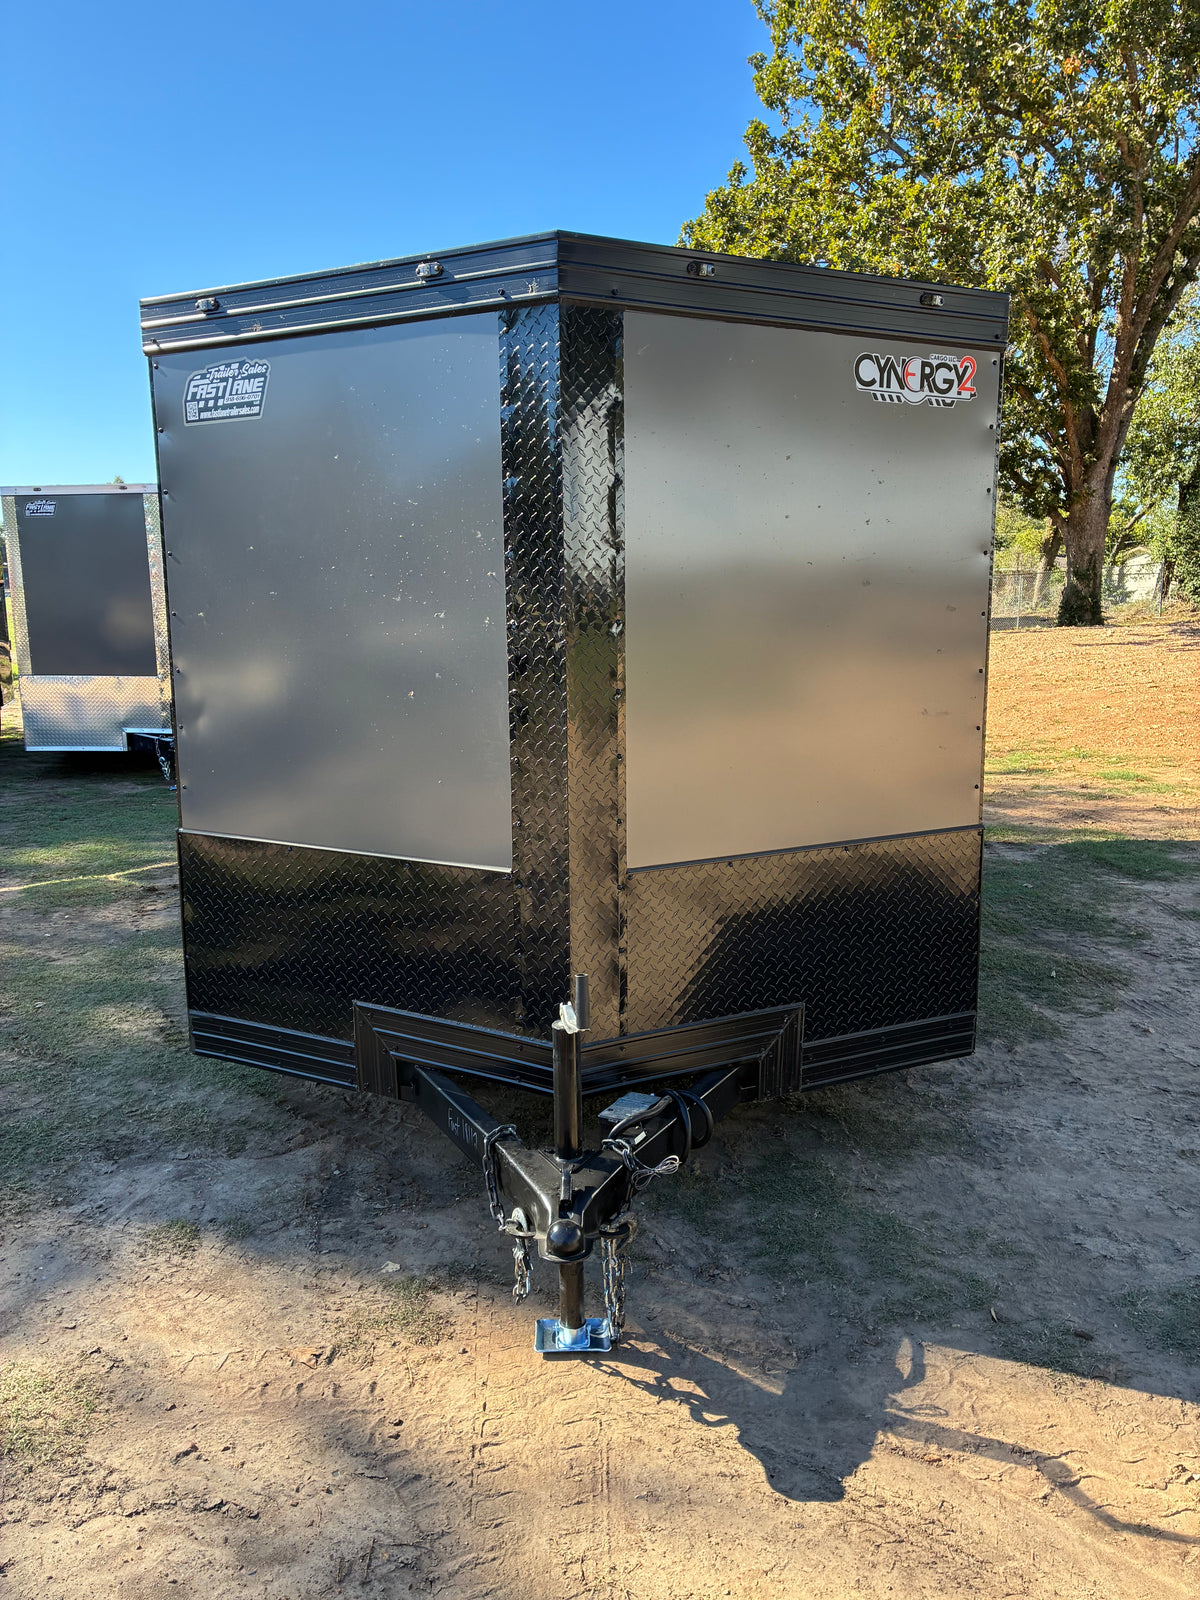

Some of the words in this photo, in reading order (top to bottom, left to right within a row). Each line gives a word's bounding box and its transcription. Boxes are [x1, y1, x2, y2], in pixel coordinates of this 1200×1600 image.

[930, 354, 947, 362] CARGO
[206, 366, 239, 381] Trailer
[240, 362, 267, 377] Sales
[187, 379, 227, 400] FAST
[226, 377, 264, 398] LANE
